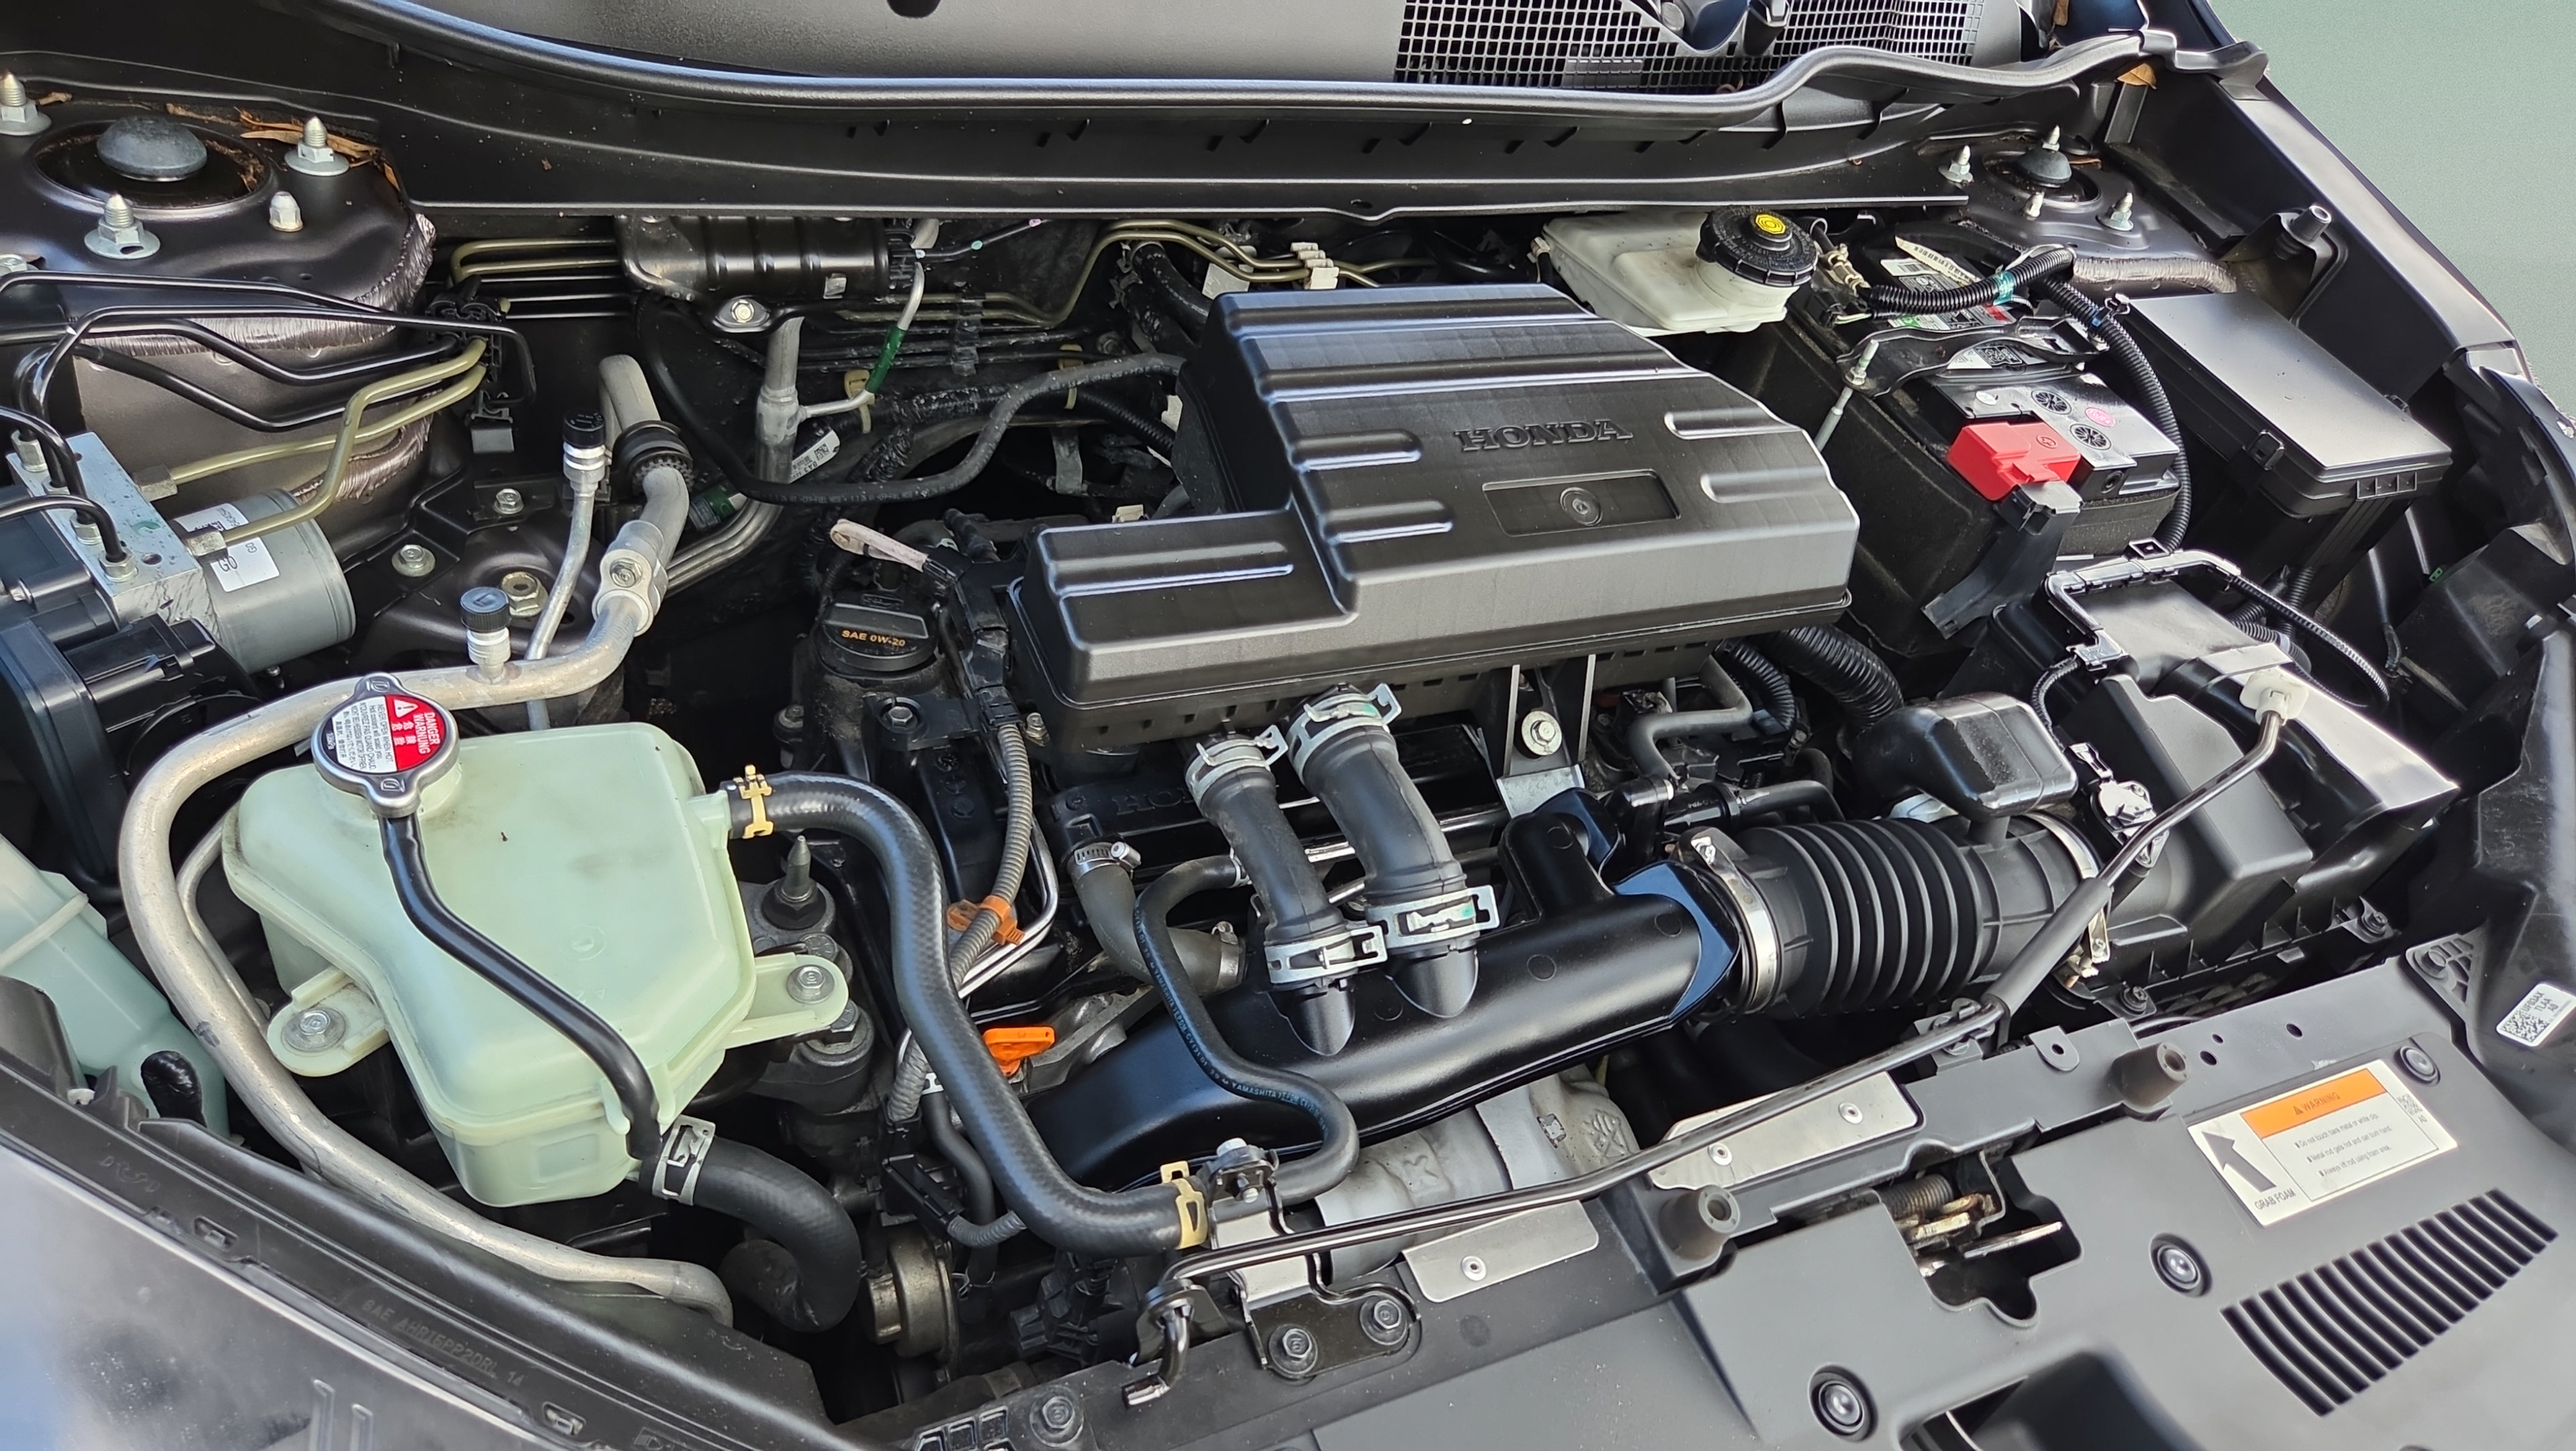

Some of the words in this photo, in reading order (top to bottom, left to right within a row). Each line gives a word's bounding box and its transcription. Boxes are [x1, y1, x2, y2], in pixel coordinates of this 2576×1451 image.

[1453, 419, 1633, 451] HONDA
[841, 630, 867, 640] SAE
[870, 635, 906, 647] 0W-20
[377, 703, 385, 721] NEVER
[379, 721, 388, 735] OPEN
[413, 713, 430, 754] WARNUNG
[424, 711, 441, 745] DANGER
[381, 736, 391, 751] WHEN
[1232, 1082, 1277, 1098] YAMASHITA
[2302, 1092, 2340, 1111] WARNING
[2254, 1196, 2276, 1209] GRAB
[2274, 1188, 2297, 1202] FOAM
